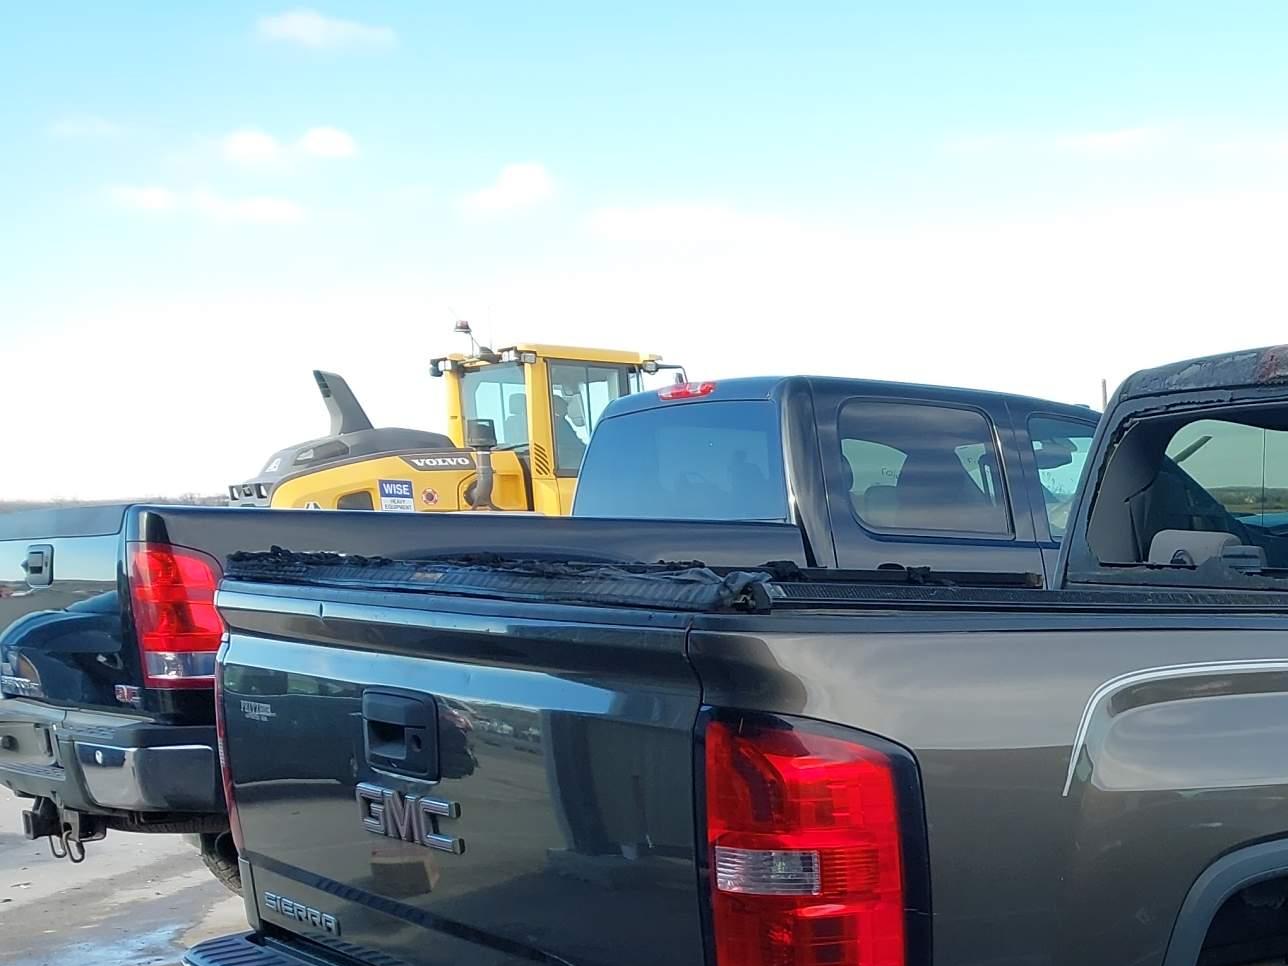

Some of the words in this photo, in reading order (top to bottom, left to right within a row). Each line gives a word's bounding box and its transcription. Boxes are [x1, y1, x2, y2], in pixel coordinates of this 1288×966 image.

[410, 457, 470, 467] VOLVO
[382, 483, 410, 495] WISE
[355, 781, 466, 855] GMC
[263, 890, 341, 937] SIERRA
